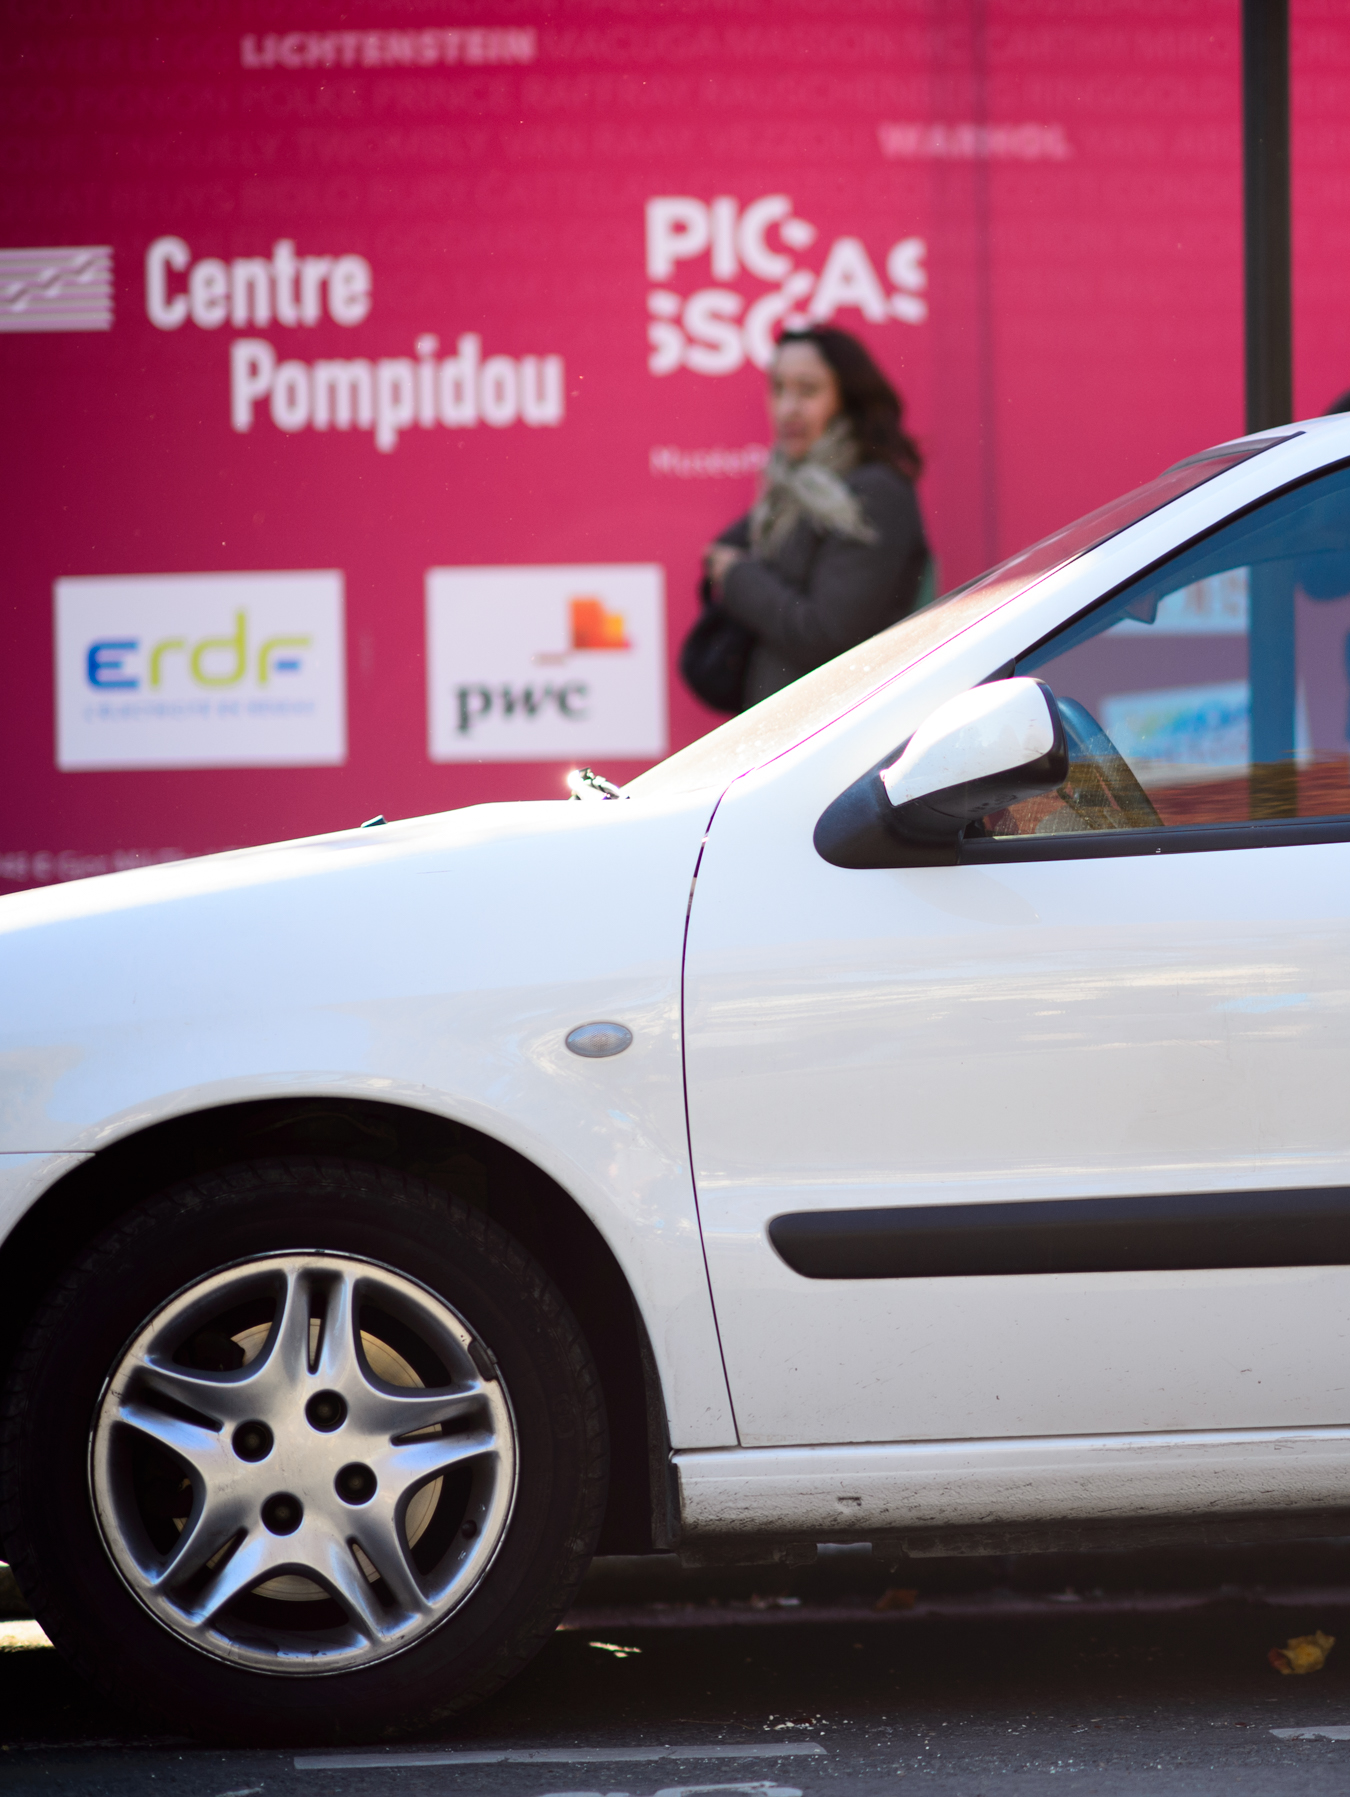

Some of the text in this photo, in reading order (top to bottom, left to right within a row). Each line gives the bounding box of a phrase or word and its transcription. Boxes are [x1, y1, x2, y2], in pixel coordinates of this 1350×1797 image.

[240, 27, 537, 69] LICHTENSTEIN
[877, 121, 1073, 161] WARHOL
[146, 235, 373, 331] Centre
[231, 331, 565, 454] Pompidou
[456, 678, 590, 738] pwc
